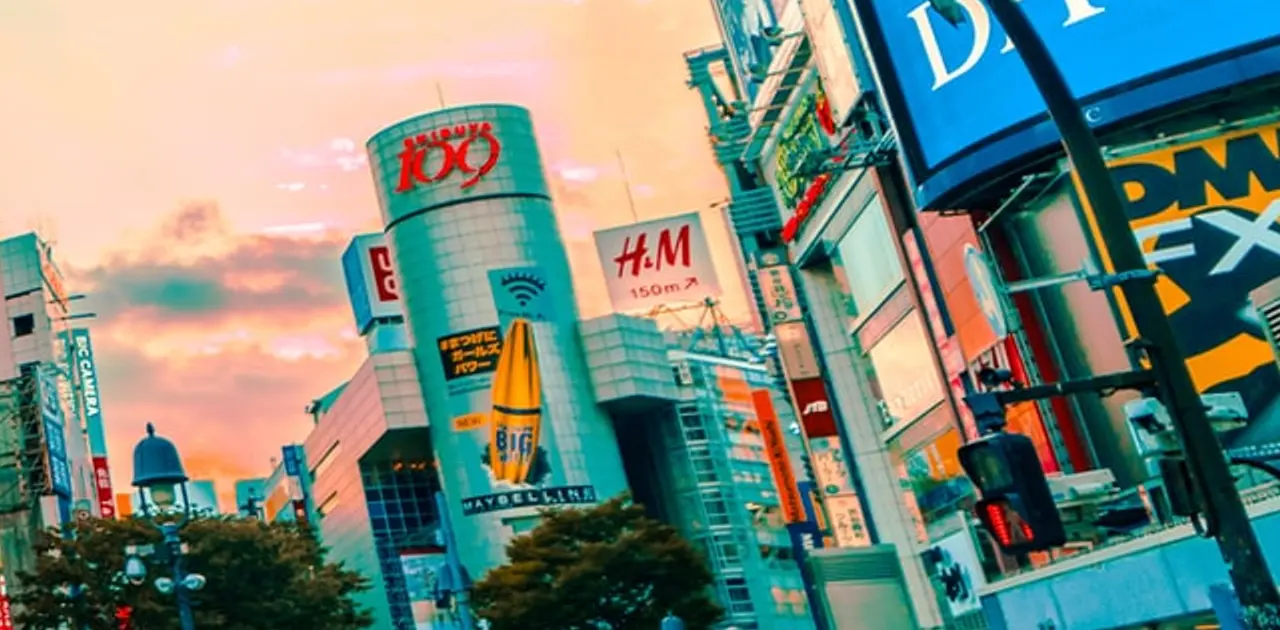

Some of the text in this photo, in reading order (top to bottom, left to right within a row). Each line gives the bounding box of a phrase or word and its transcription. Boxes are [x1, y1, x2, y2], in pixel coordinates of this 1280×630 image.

[395, 132, 502, 193] 109
[613, 224, 691, 278] H&M
[630, 282, 681, 299] 150m
[80, 359, 101, 417] CAMERA
